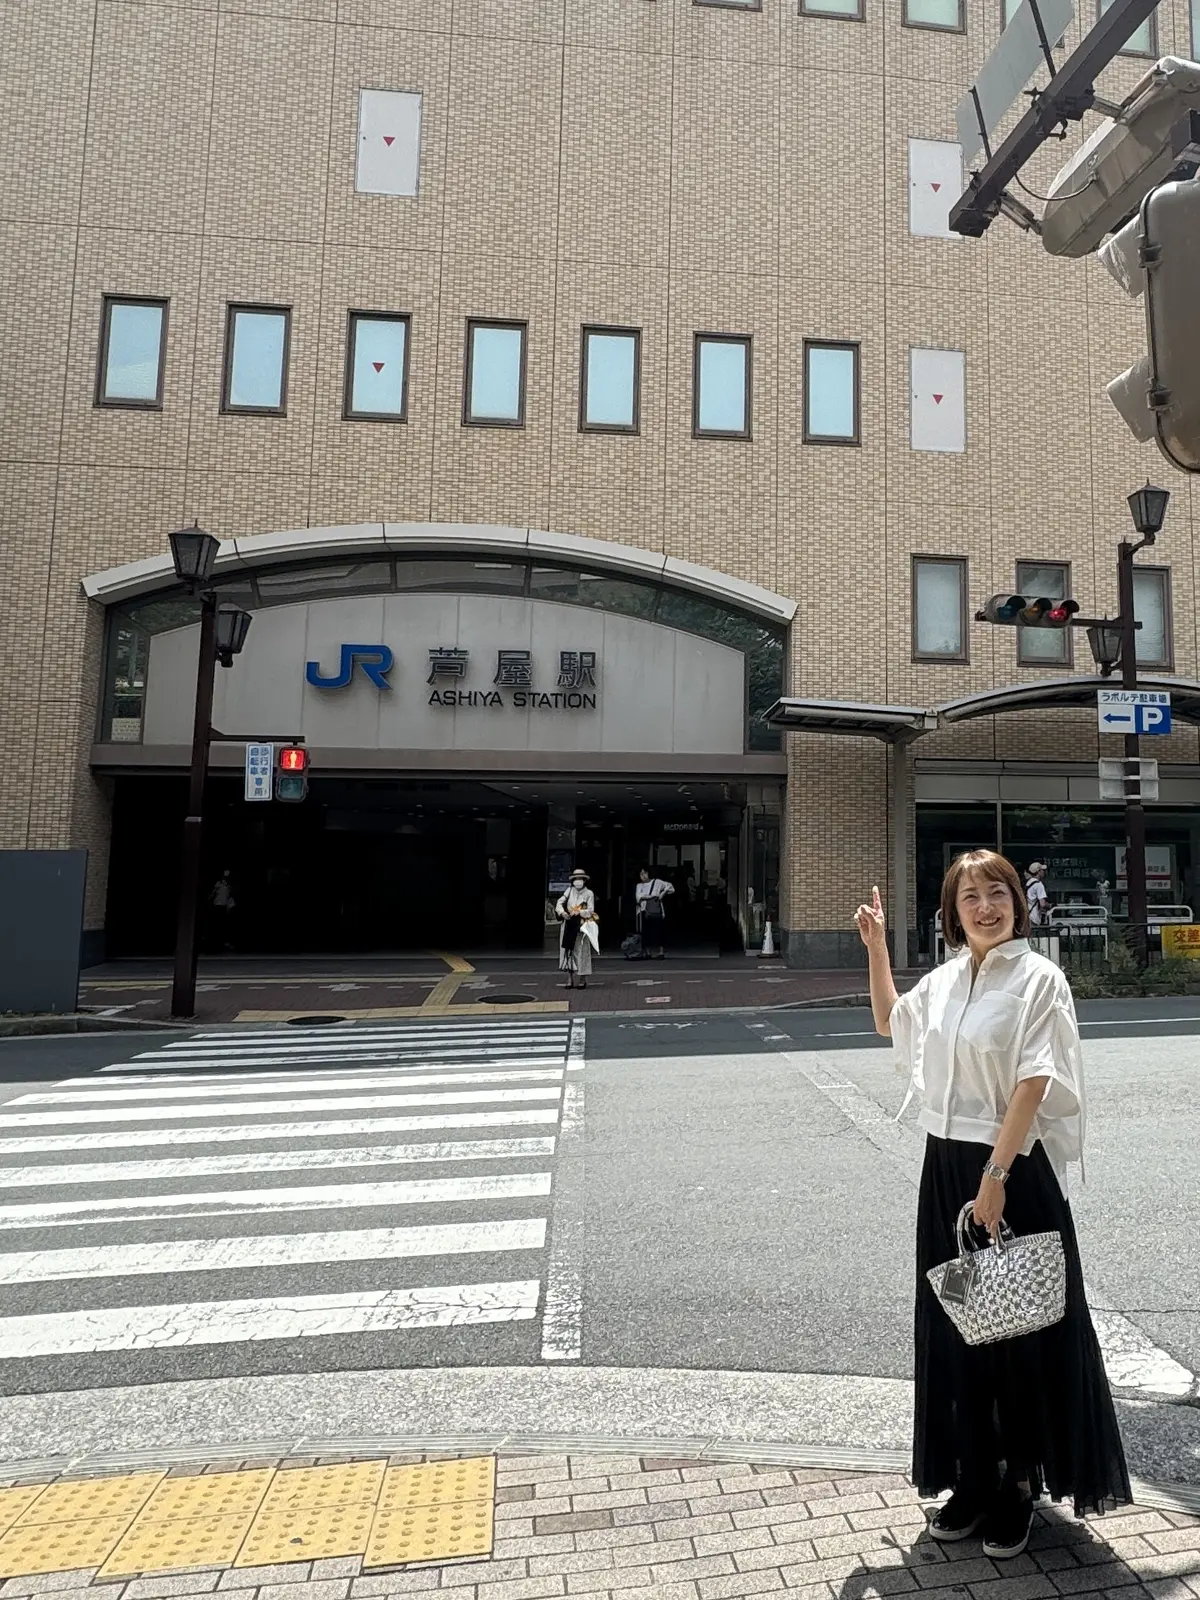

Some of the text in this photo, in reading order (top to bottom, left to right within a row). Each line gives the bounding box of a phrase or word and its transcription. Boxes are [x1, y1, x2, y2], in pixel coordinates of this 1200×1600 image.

[306, 643, 393, 690] JR
[426, 647, 597, 689] 芦屋駅
[427, 690, 597, 708] ASHIYA STATION
[1102, 692, 1167, 703] ラポルテ駐車場
[1142, 707, 1163, 731] P
